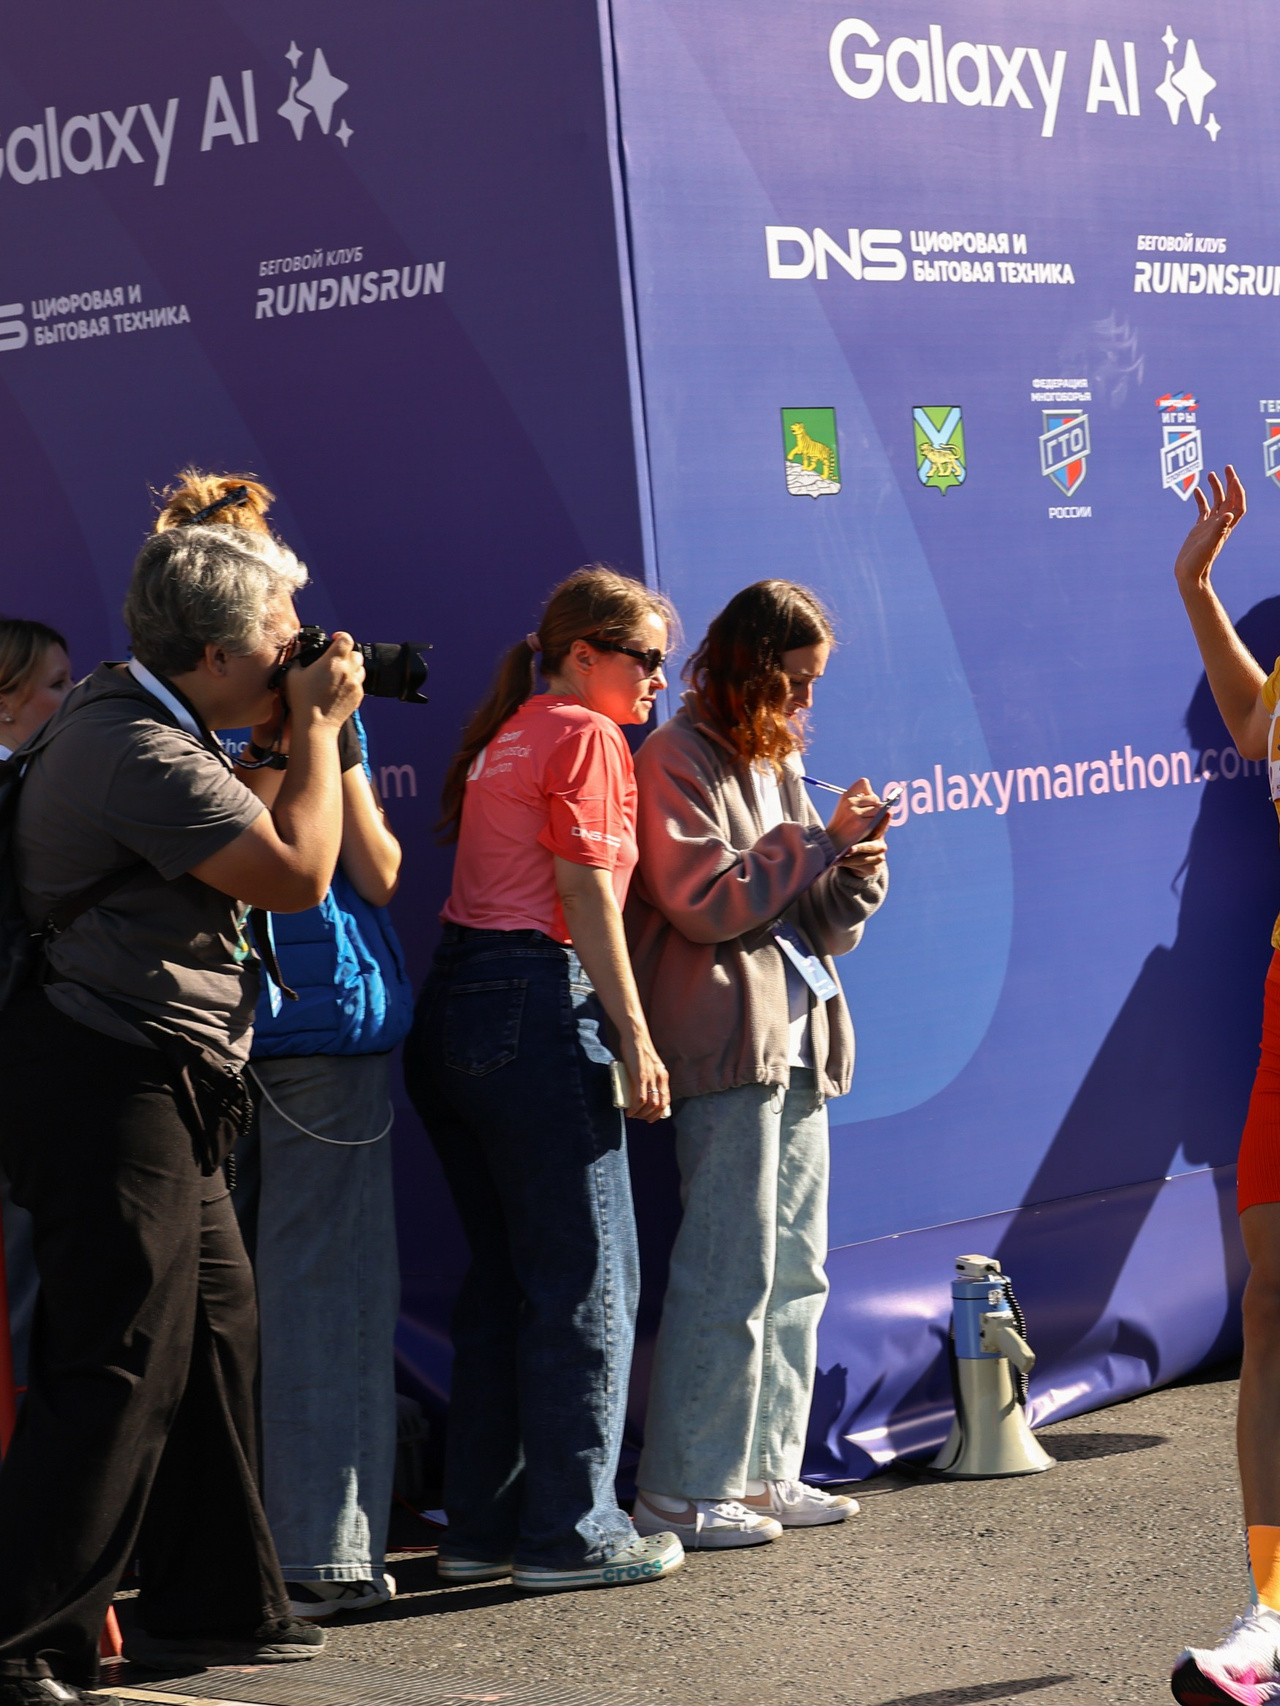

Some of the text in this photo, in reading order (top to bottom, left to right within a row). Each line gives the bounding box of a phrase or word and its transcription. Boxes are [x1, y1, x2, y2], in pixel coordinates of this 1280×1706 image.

[829, 18, 1140, 137] Galaxy AI
[0, 70, 259, 186] alaxy AI
[765, 226, 907, 281] DNS
[910, 230, 1028, 255] ЦИФРОВАЯ И
[1136, 232, 1227, 253] БЕГОВОЙ КЛУБ
[258, 246, 363, 277] БЕГОВОЙ КЛУБ
[912, 260, 1075, 284] БЫТОВАЯ ТЕХНИКА
[31, 284, 142, 320] ЦИФРОВАЯ И
[255, 261, 446, 319] RUNDNSRUN
[34, 313, 109, 346] БЫТОВАЯ
[114, 304, 190, 334] ТЕХНИКА
[1032, 378, 1088, 389] ФЕДЕРАЦИЯ
[1161, 412, 1197, 423] ИГРЫ
[1046, 427, 1083, 465] ГТО
[1166, 441, 1197, 473] ГТО
[1048, 506, 1092, 519] РОССИИ
[602, 1559, 663, 1582] crocs
